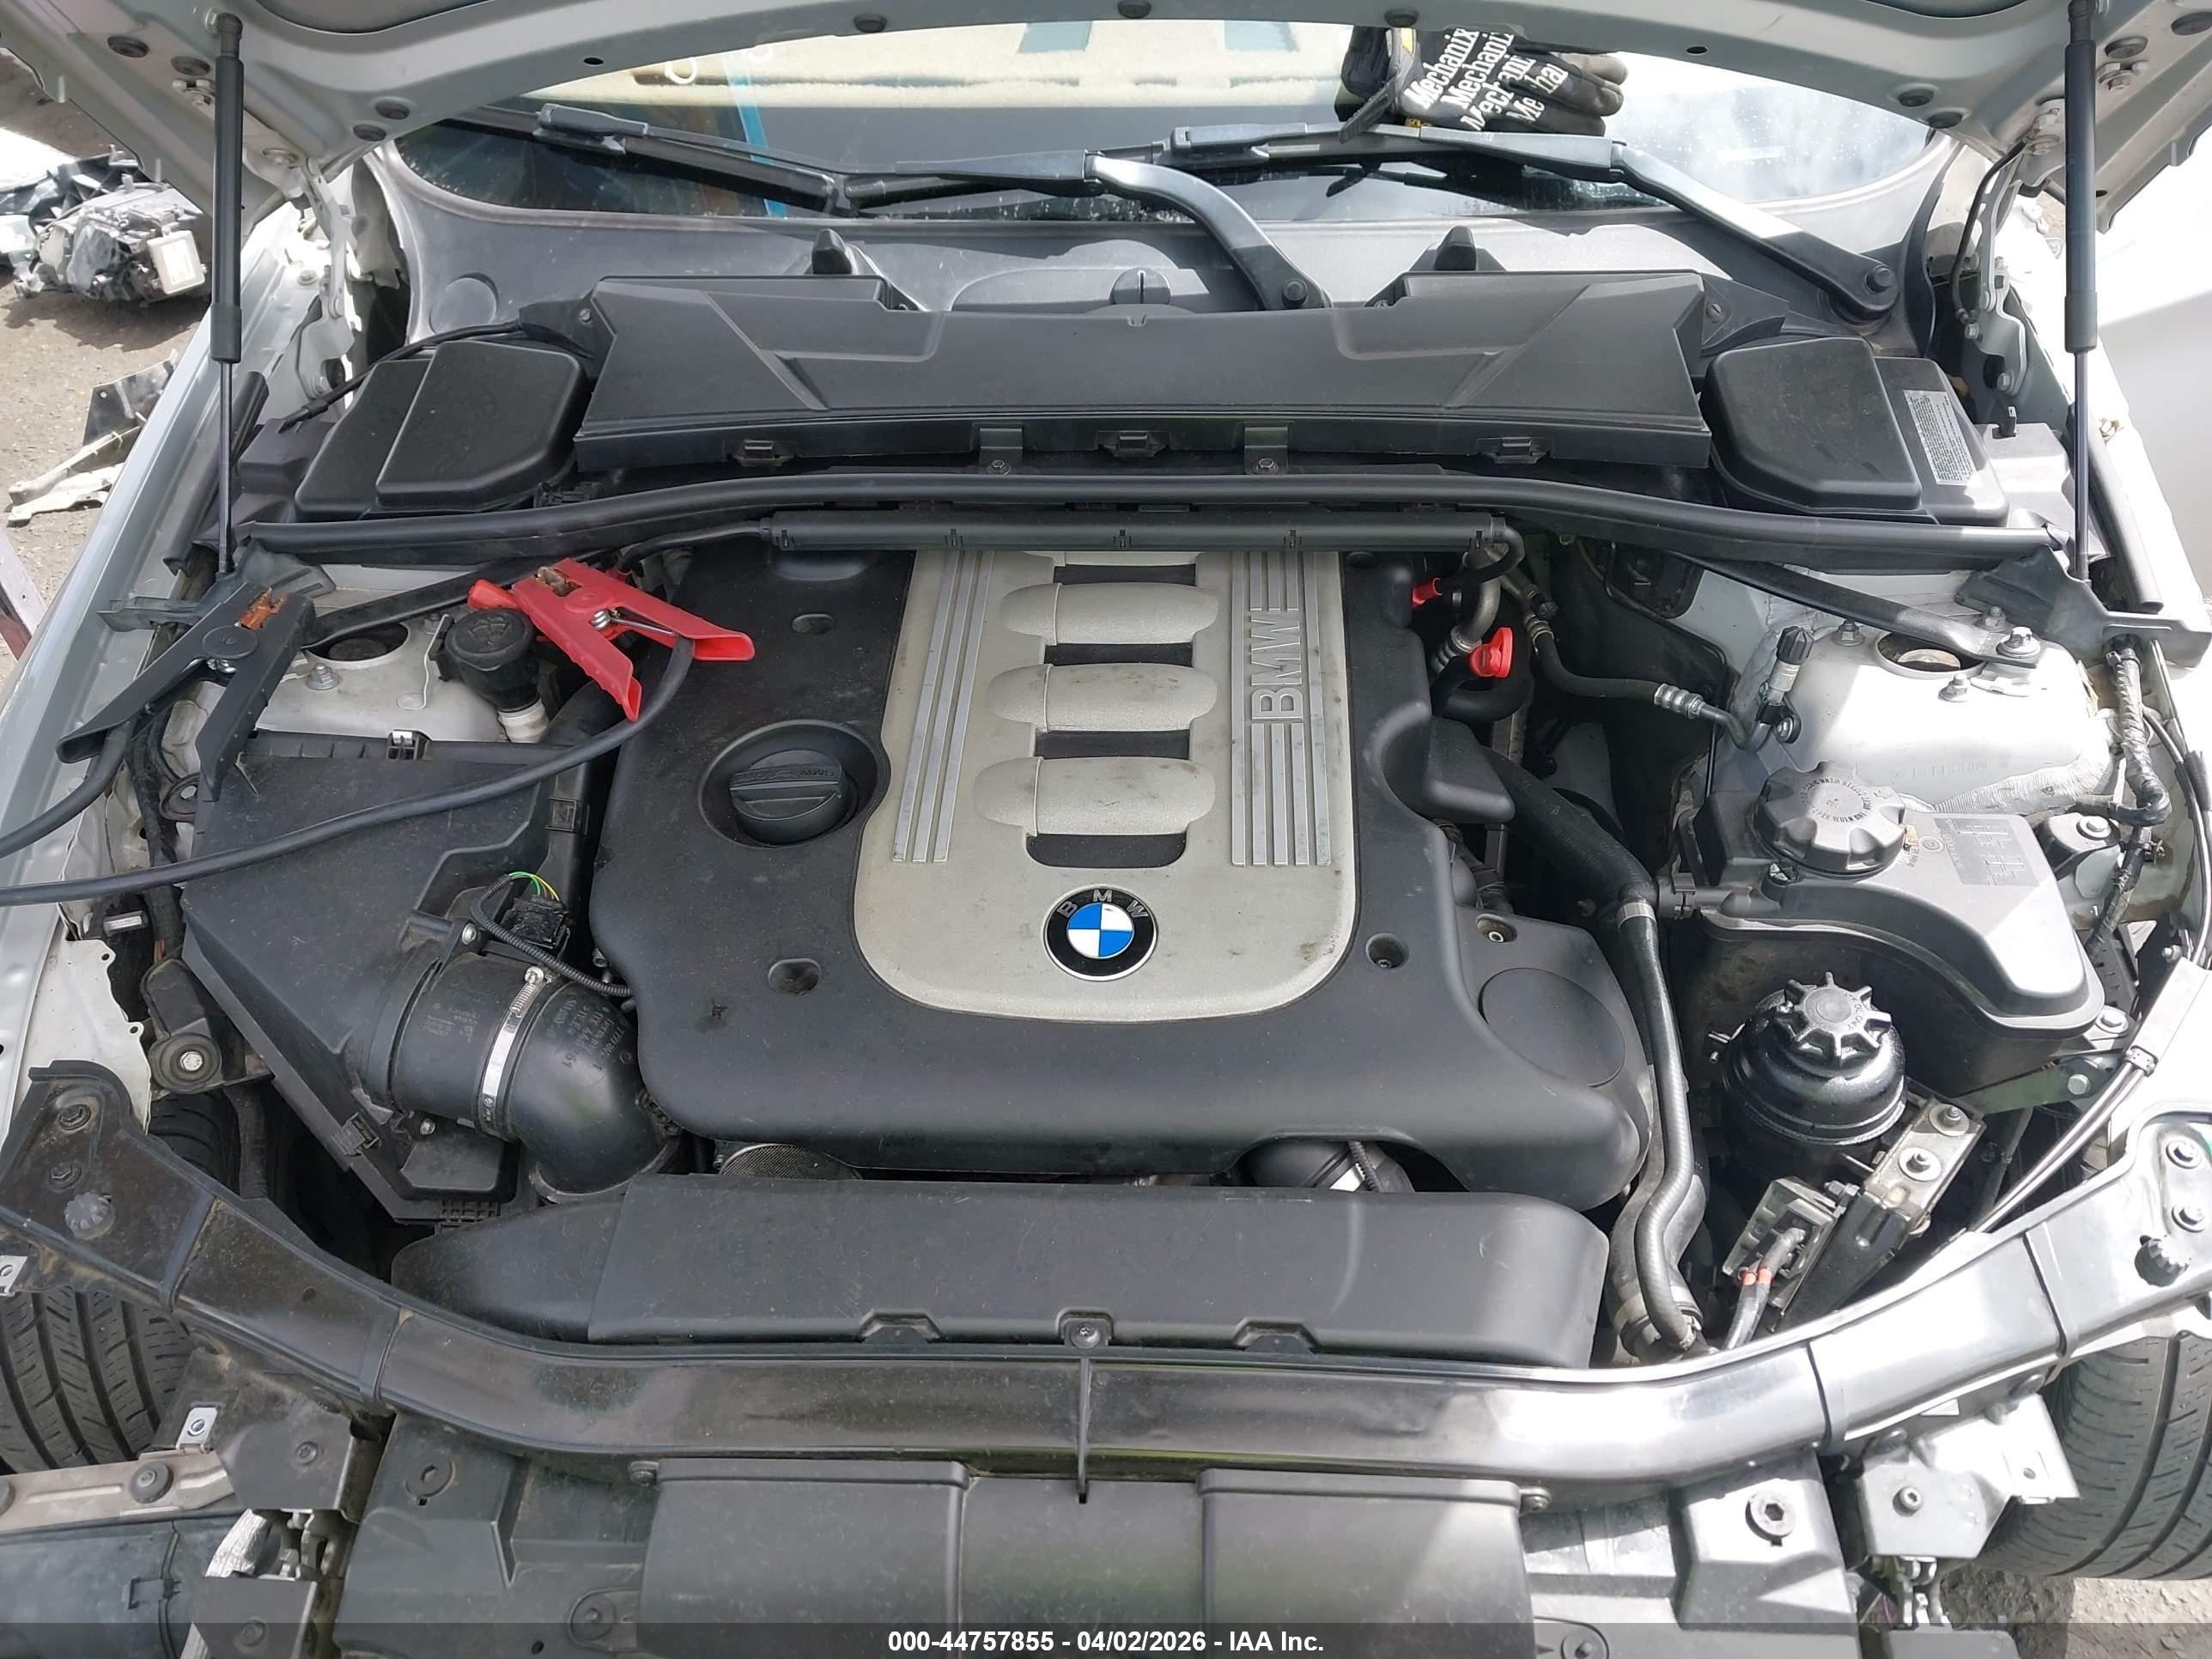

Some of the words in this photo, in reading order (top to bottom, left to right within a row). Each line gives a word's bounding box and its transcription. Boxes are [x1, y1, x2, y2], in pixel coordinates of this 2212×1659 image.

[1404, 28, 1480, 110] Mechanix
[1250, 612, 1304, 720] BMW
[1056, 889, 1149, 919] BMW
